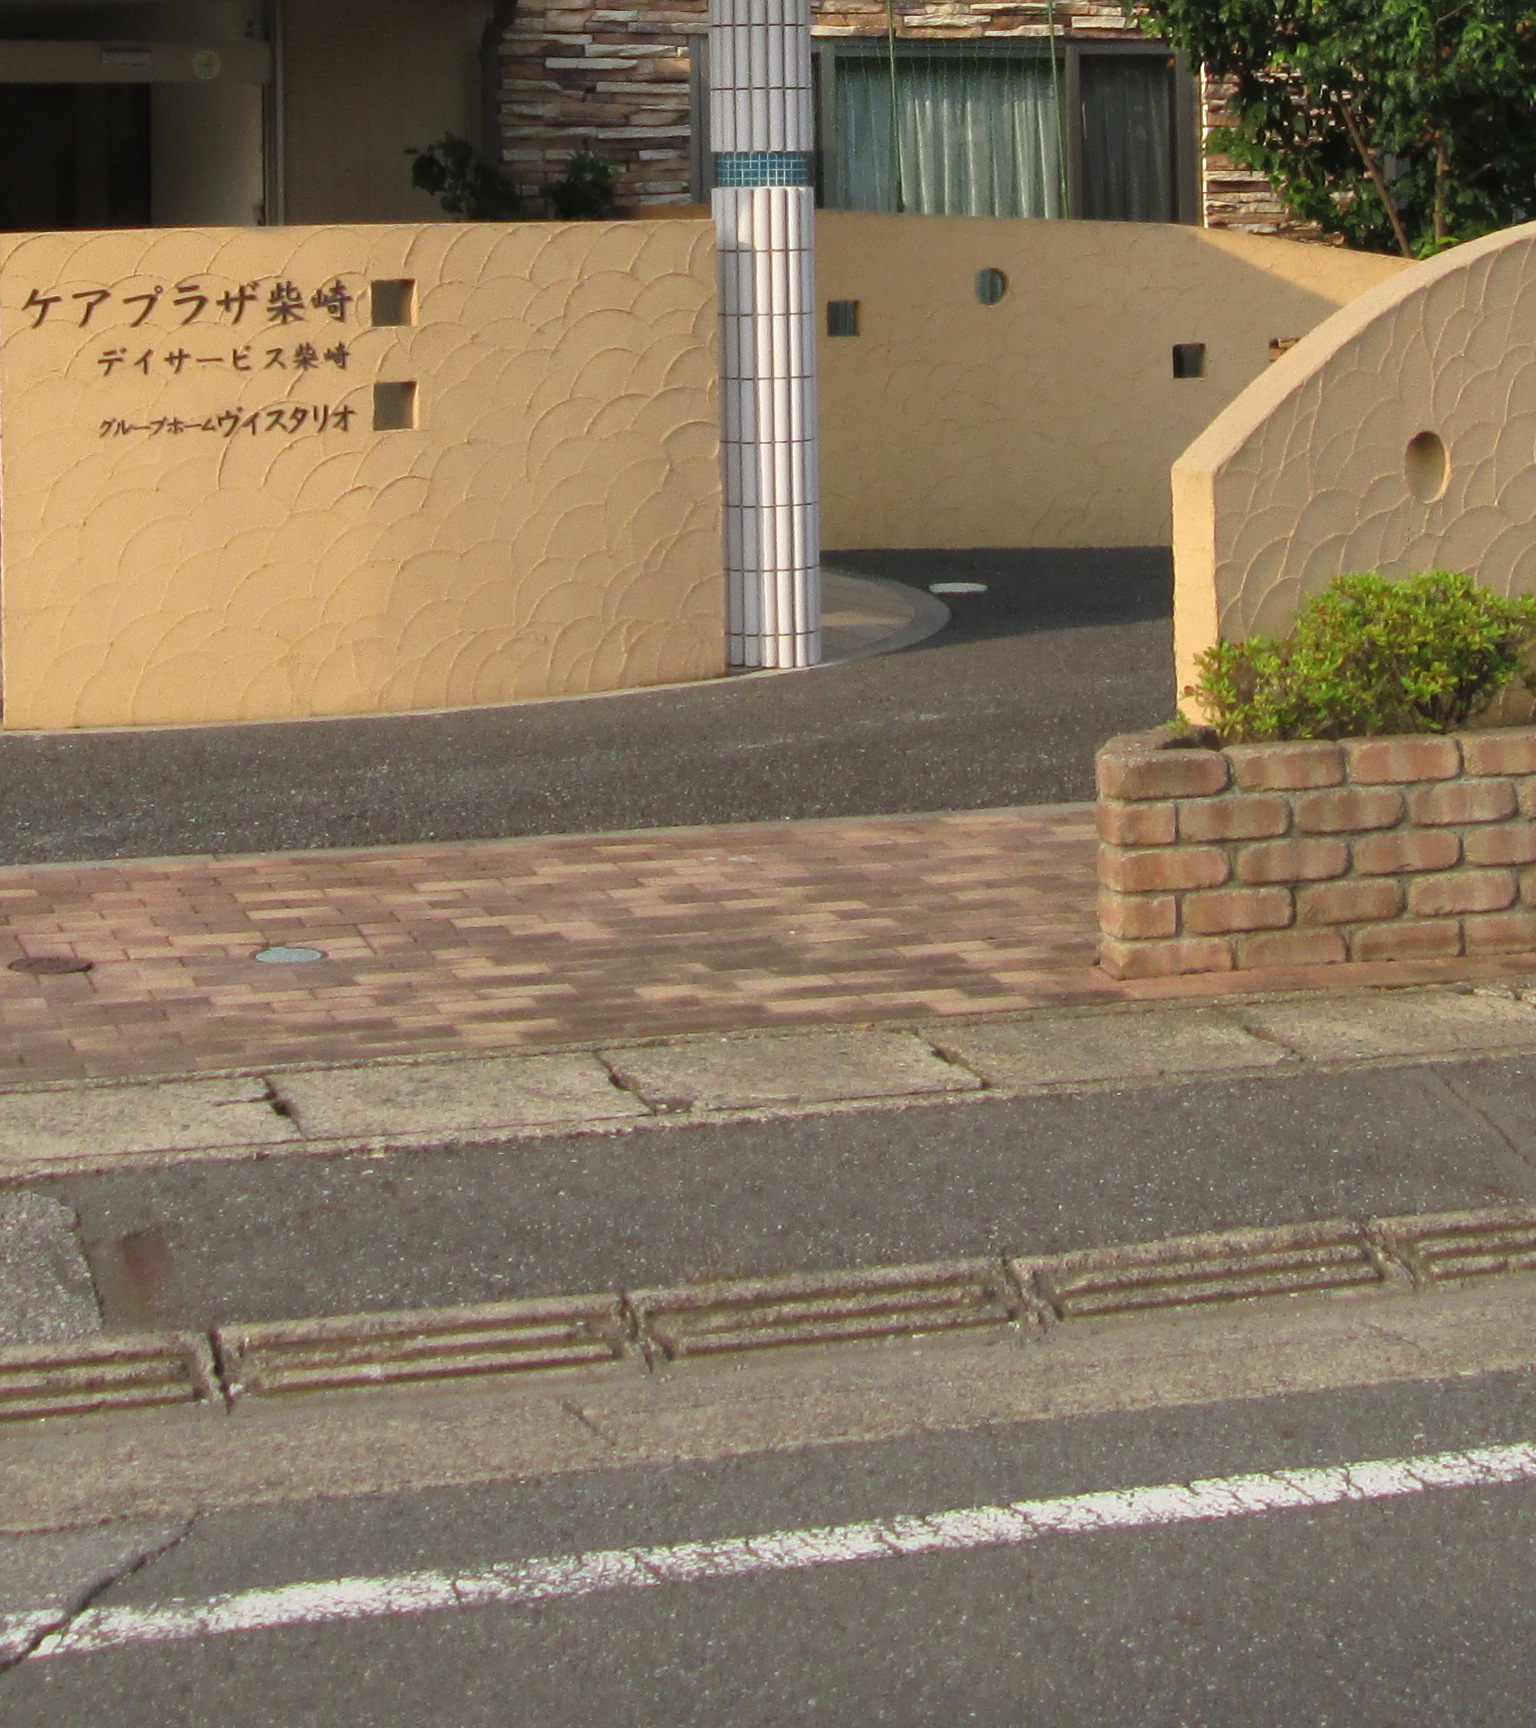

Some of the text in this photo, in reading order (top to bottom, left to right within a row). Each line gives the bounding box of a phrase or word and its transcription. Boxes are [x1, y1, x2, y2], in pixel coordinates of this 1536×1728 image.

[21, 280, 353, 328] ケアプラザ柴崎
[97, 341, 351, 376] デイサービス柴崎
